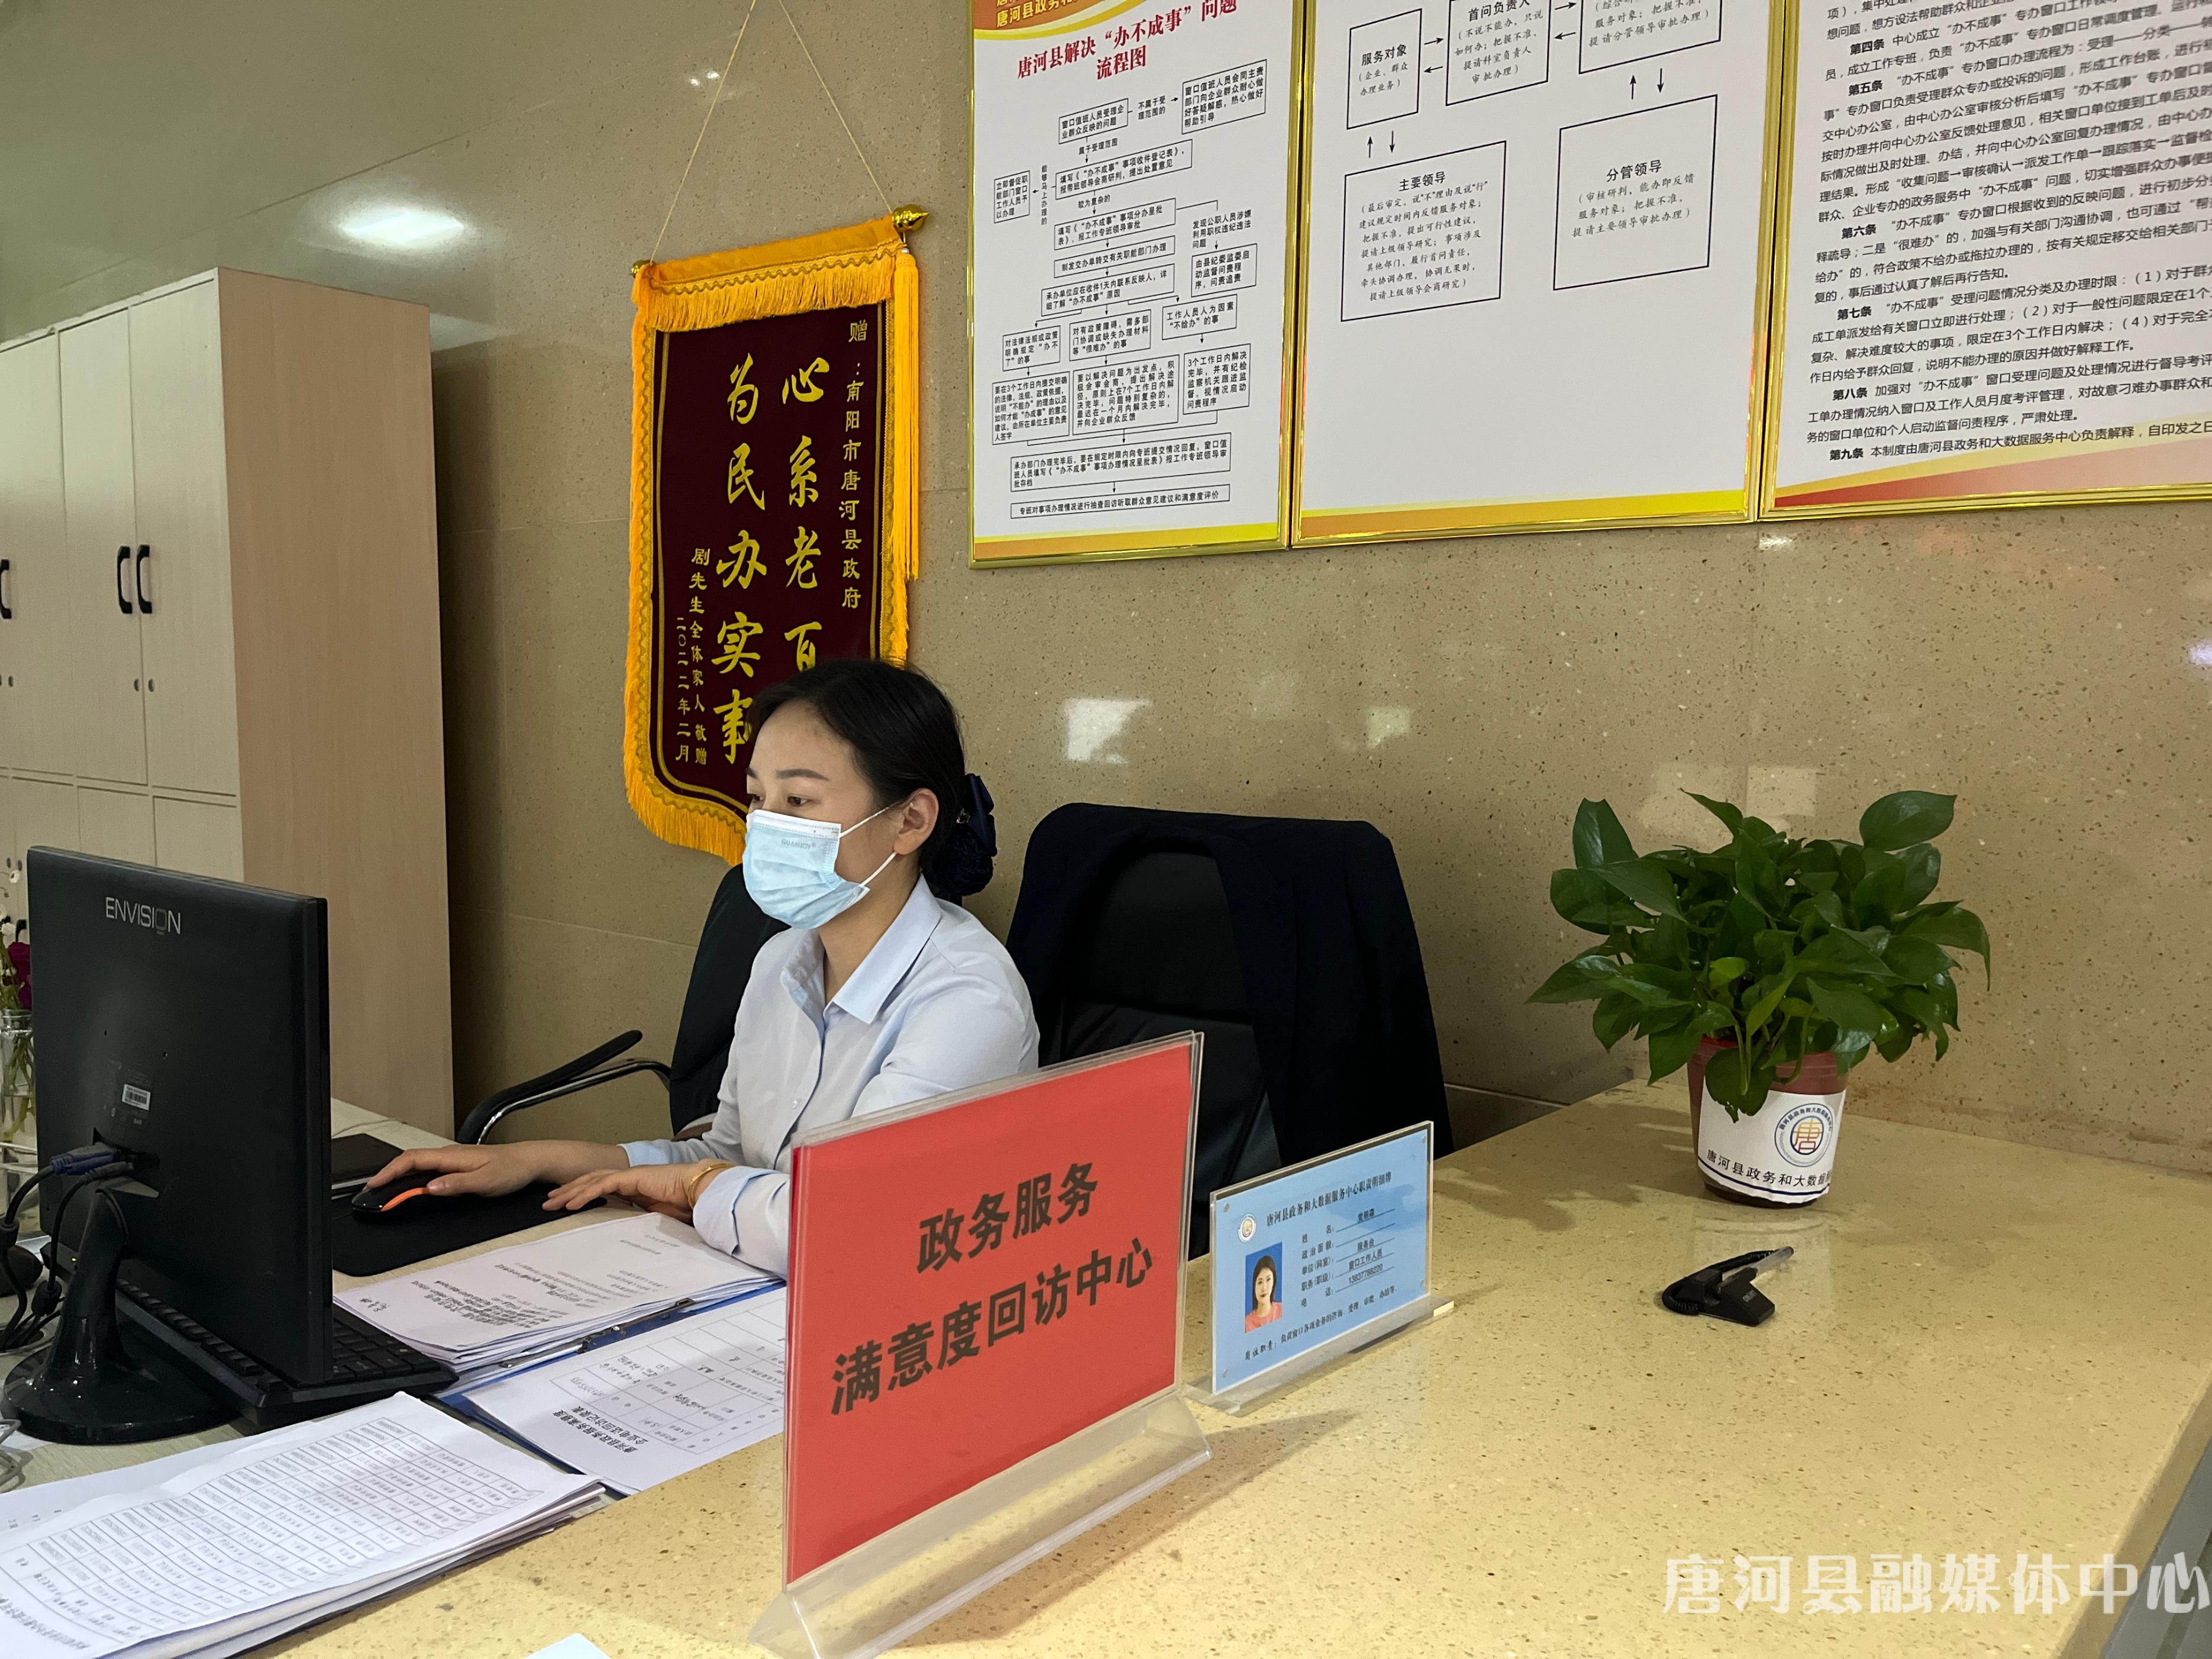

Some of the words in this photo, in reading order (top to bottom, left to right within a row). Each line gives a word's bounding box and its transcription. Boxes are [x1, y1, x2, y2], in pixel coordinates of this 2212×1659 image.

[1018, 0, 1237, 79] 唐河县解决“办不成事”问题
[1850, 39, 1885, 55] 第四条
[1097, 45, 1146, 80] 流程图
[1361, 43, 1407, 66] 服务对象
[1848, 80, 1883, 96] 第五条
[1138, 95, 1165, 109] 不属于受
[1078, 137, 1118, 155] 属于受理范围
[1606, 159, 1662, 183] 分管领导
[1399, 171, 1446, 192] 主要领导
[996, 208, 1015, 219] 以办理
[1841, 224, 1877, 240] 第六条
[1193, 239, 1206, 249] 问题
[1837, 305, 1872, 321] 第七条
[1832, 387, 1868, 401] 第八条
[1829, 449, 1864, 461] 第九条
[711, 352, 767, 764] 为民办实事
[916, 1161, 1099, 1274] 政务服务
[831, 1237, 1153, 1415] 满意度回访中心
